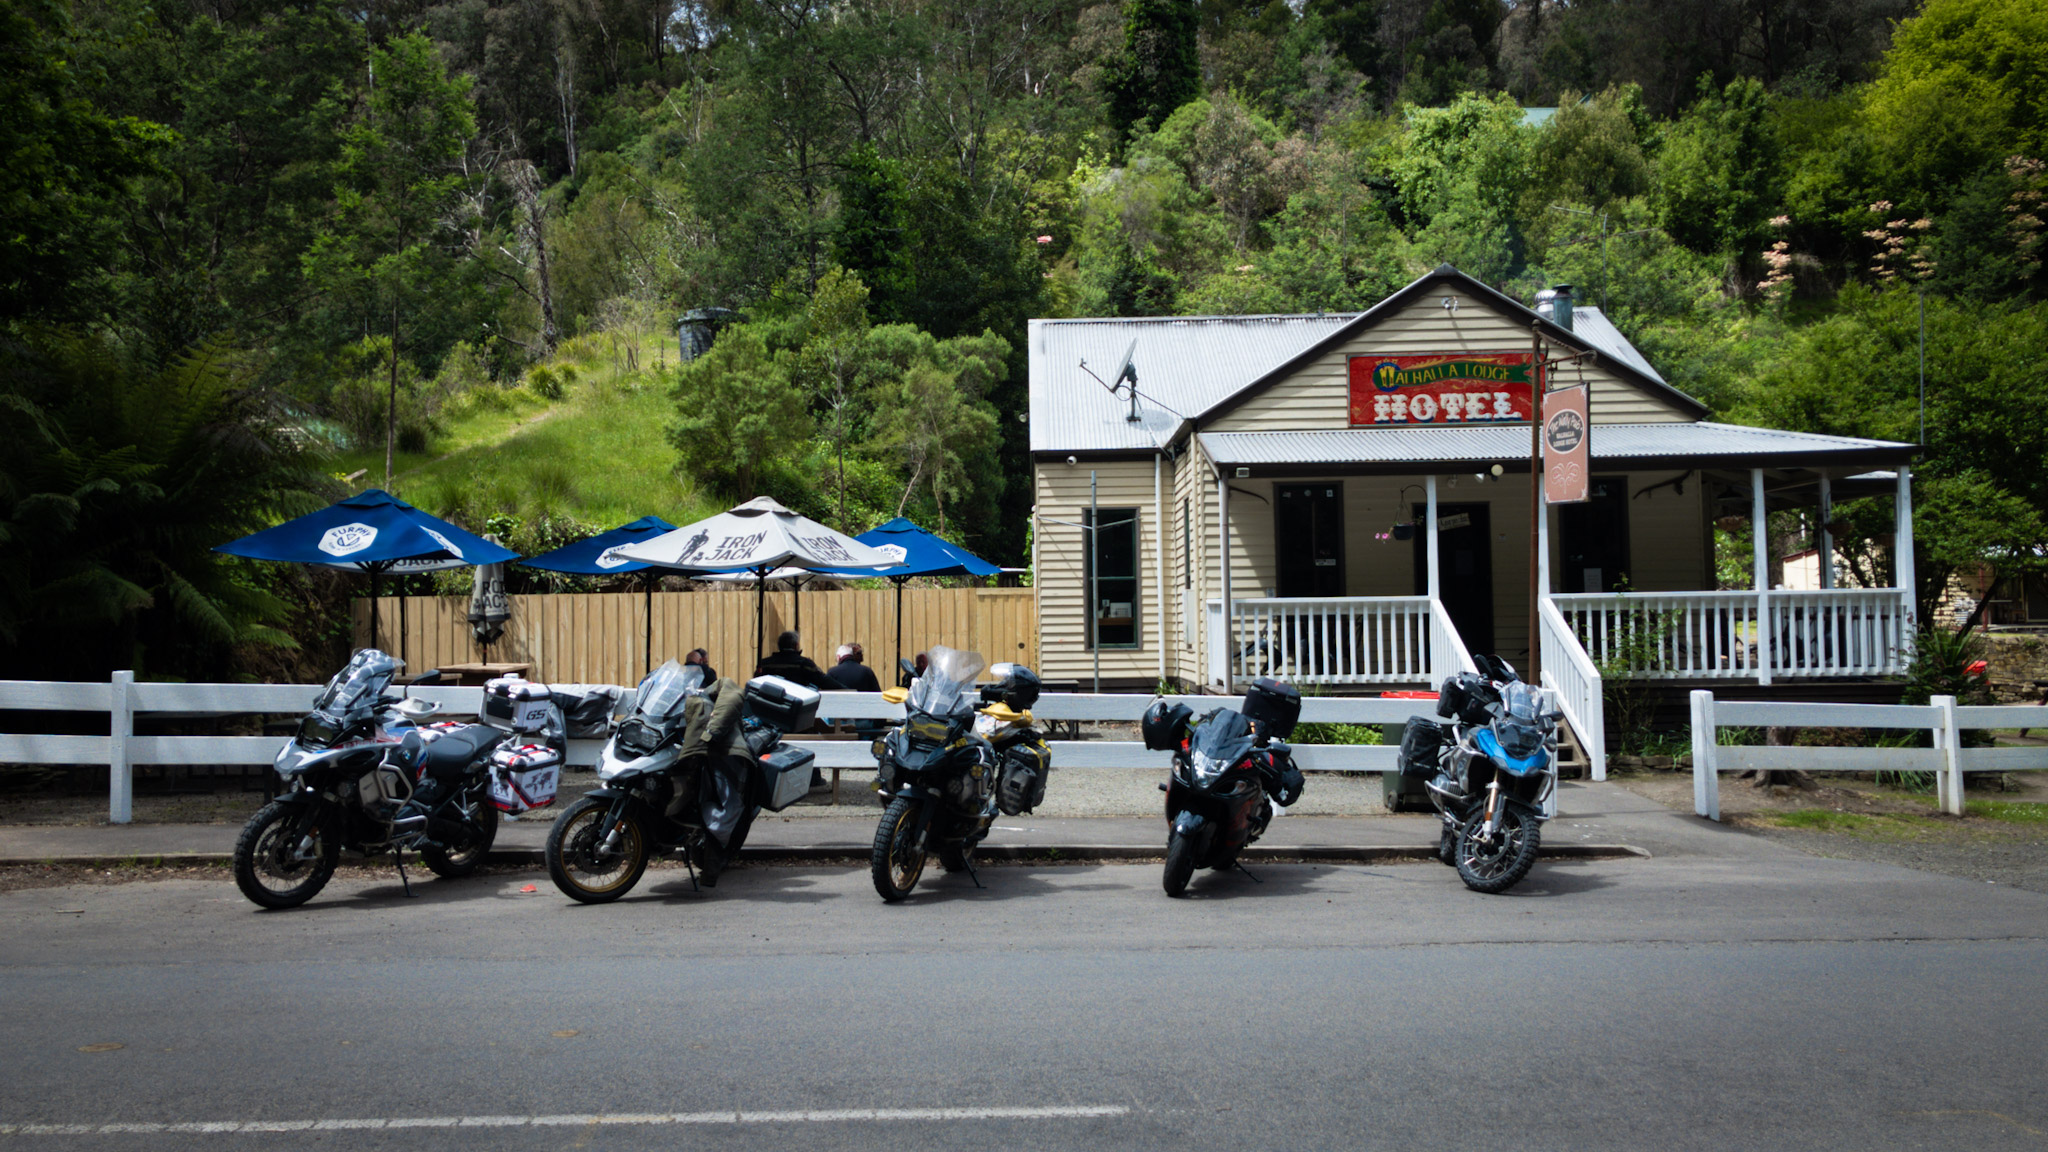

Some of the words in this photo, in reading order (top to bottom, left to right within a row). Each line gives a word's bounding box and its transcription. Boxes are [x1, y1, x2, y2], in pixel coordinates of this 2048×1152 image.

[1466, 364, 1512, 380] LODGE
[1374, 392, 1522, 423] HOTEL
[331, 526, 372, 538] FURPHY
[716, 530, 768, 549] IRON
[801, 536, 845, 550] IRON
[704, 546, 759, 561] JACK
[816, 549, 860, 561] JACK
[526, 709, 547, 721] GS
